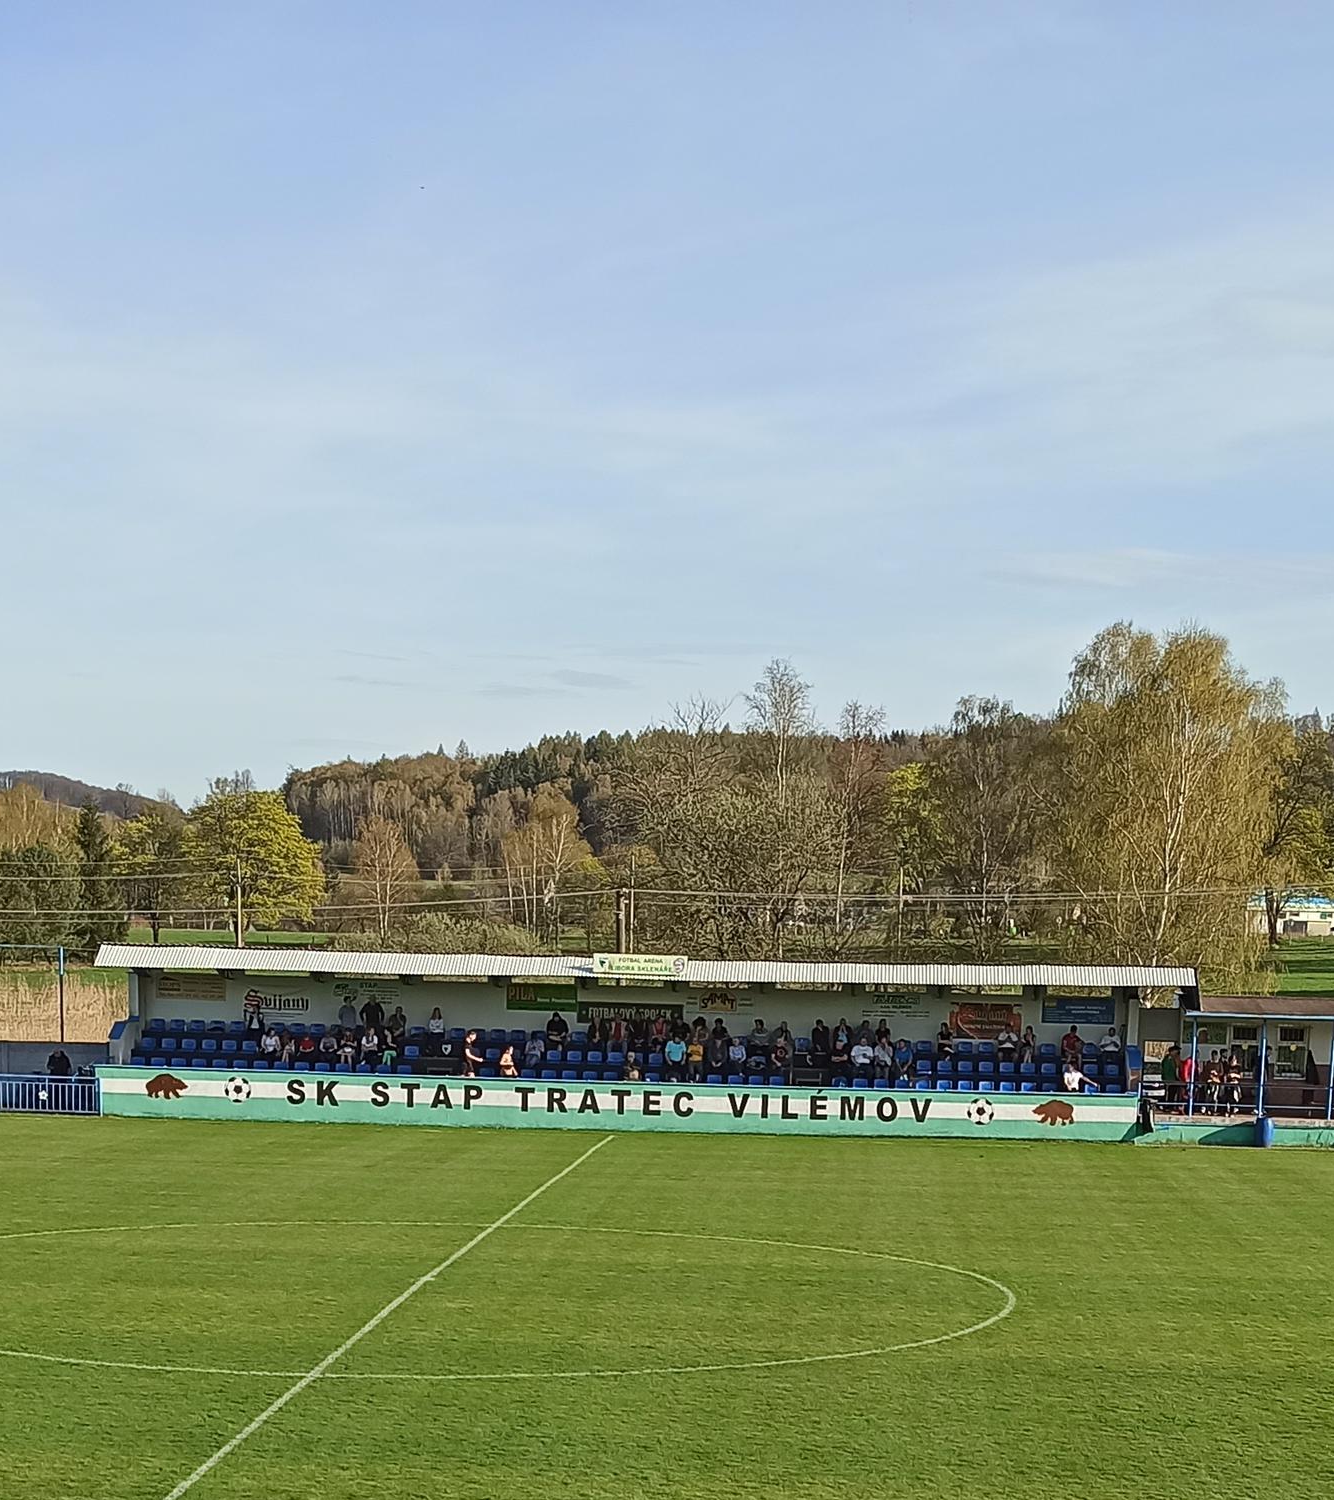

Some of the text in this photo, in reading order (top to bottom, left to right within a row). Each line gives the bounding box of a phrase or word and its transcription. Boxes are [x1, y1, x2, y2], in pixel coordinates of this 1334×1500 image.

[286, 1079, 933, 1123] SK STAP TRATEC VILÉMOV
